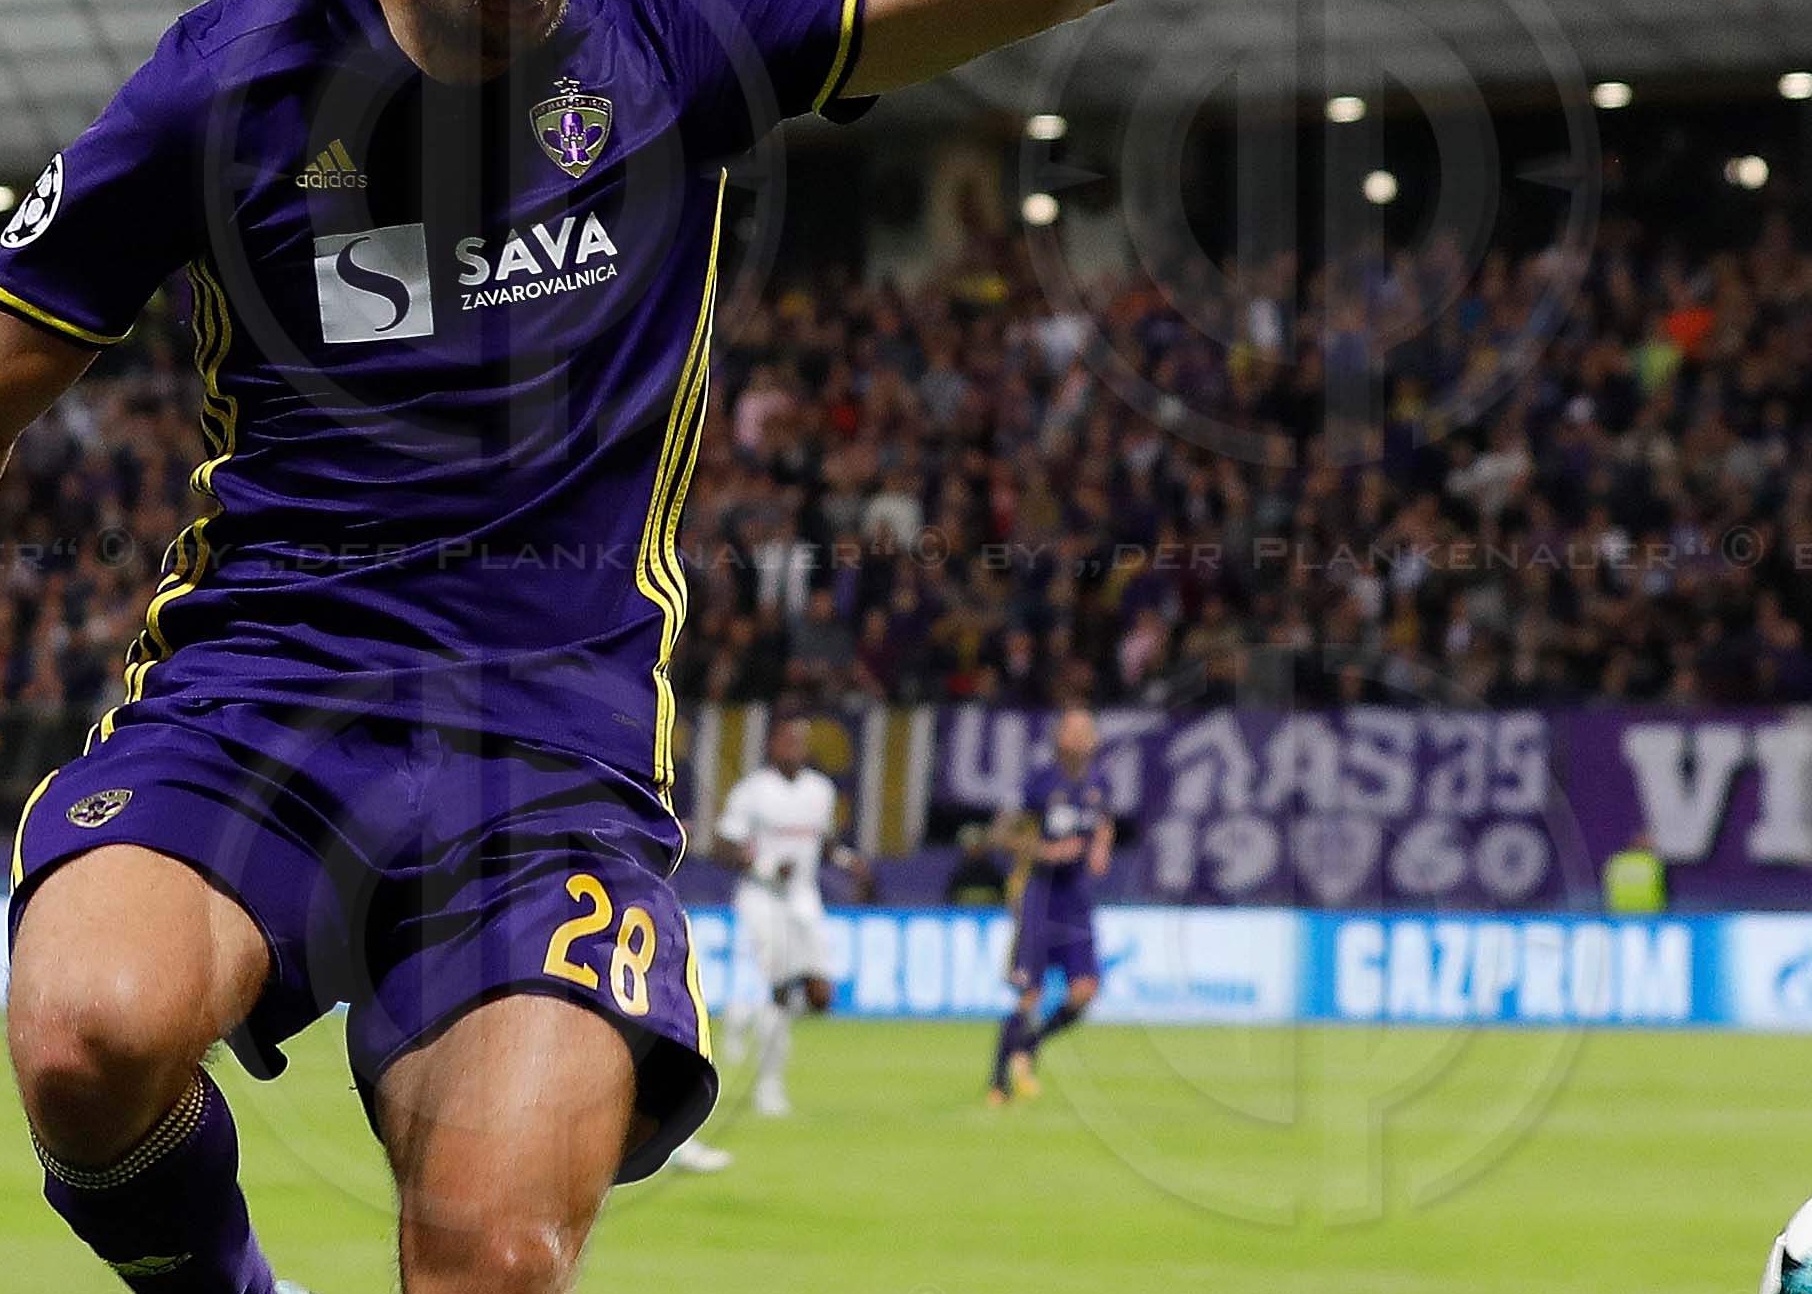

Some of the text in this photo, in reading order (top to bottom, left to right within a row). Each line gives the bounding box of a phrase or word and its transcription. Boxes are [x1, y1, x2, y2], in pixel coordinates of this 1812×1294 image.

[296, 171, 369, 189] adidas
[454, 210, 618, 287] SAVA
[460, 262, 618, 312] ZAVAROVALNICA
[543, 872, 656, 1017] 28
[1333, 920, 1691, 1021] GAZPROM
